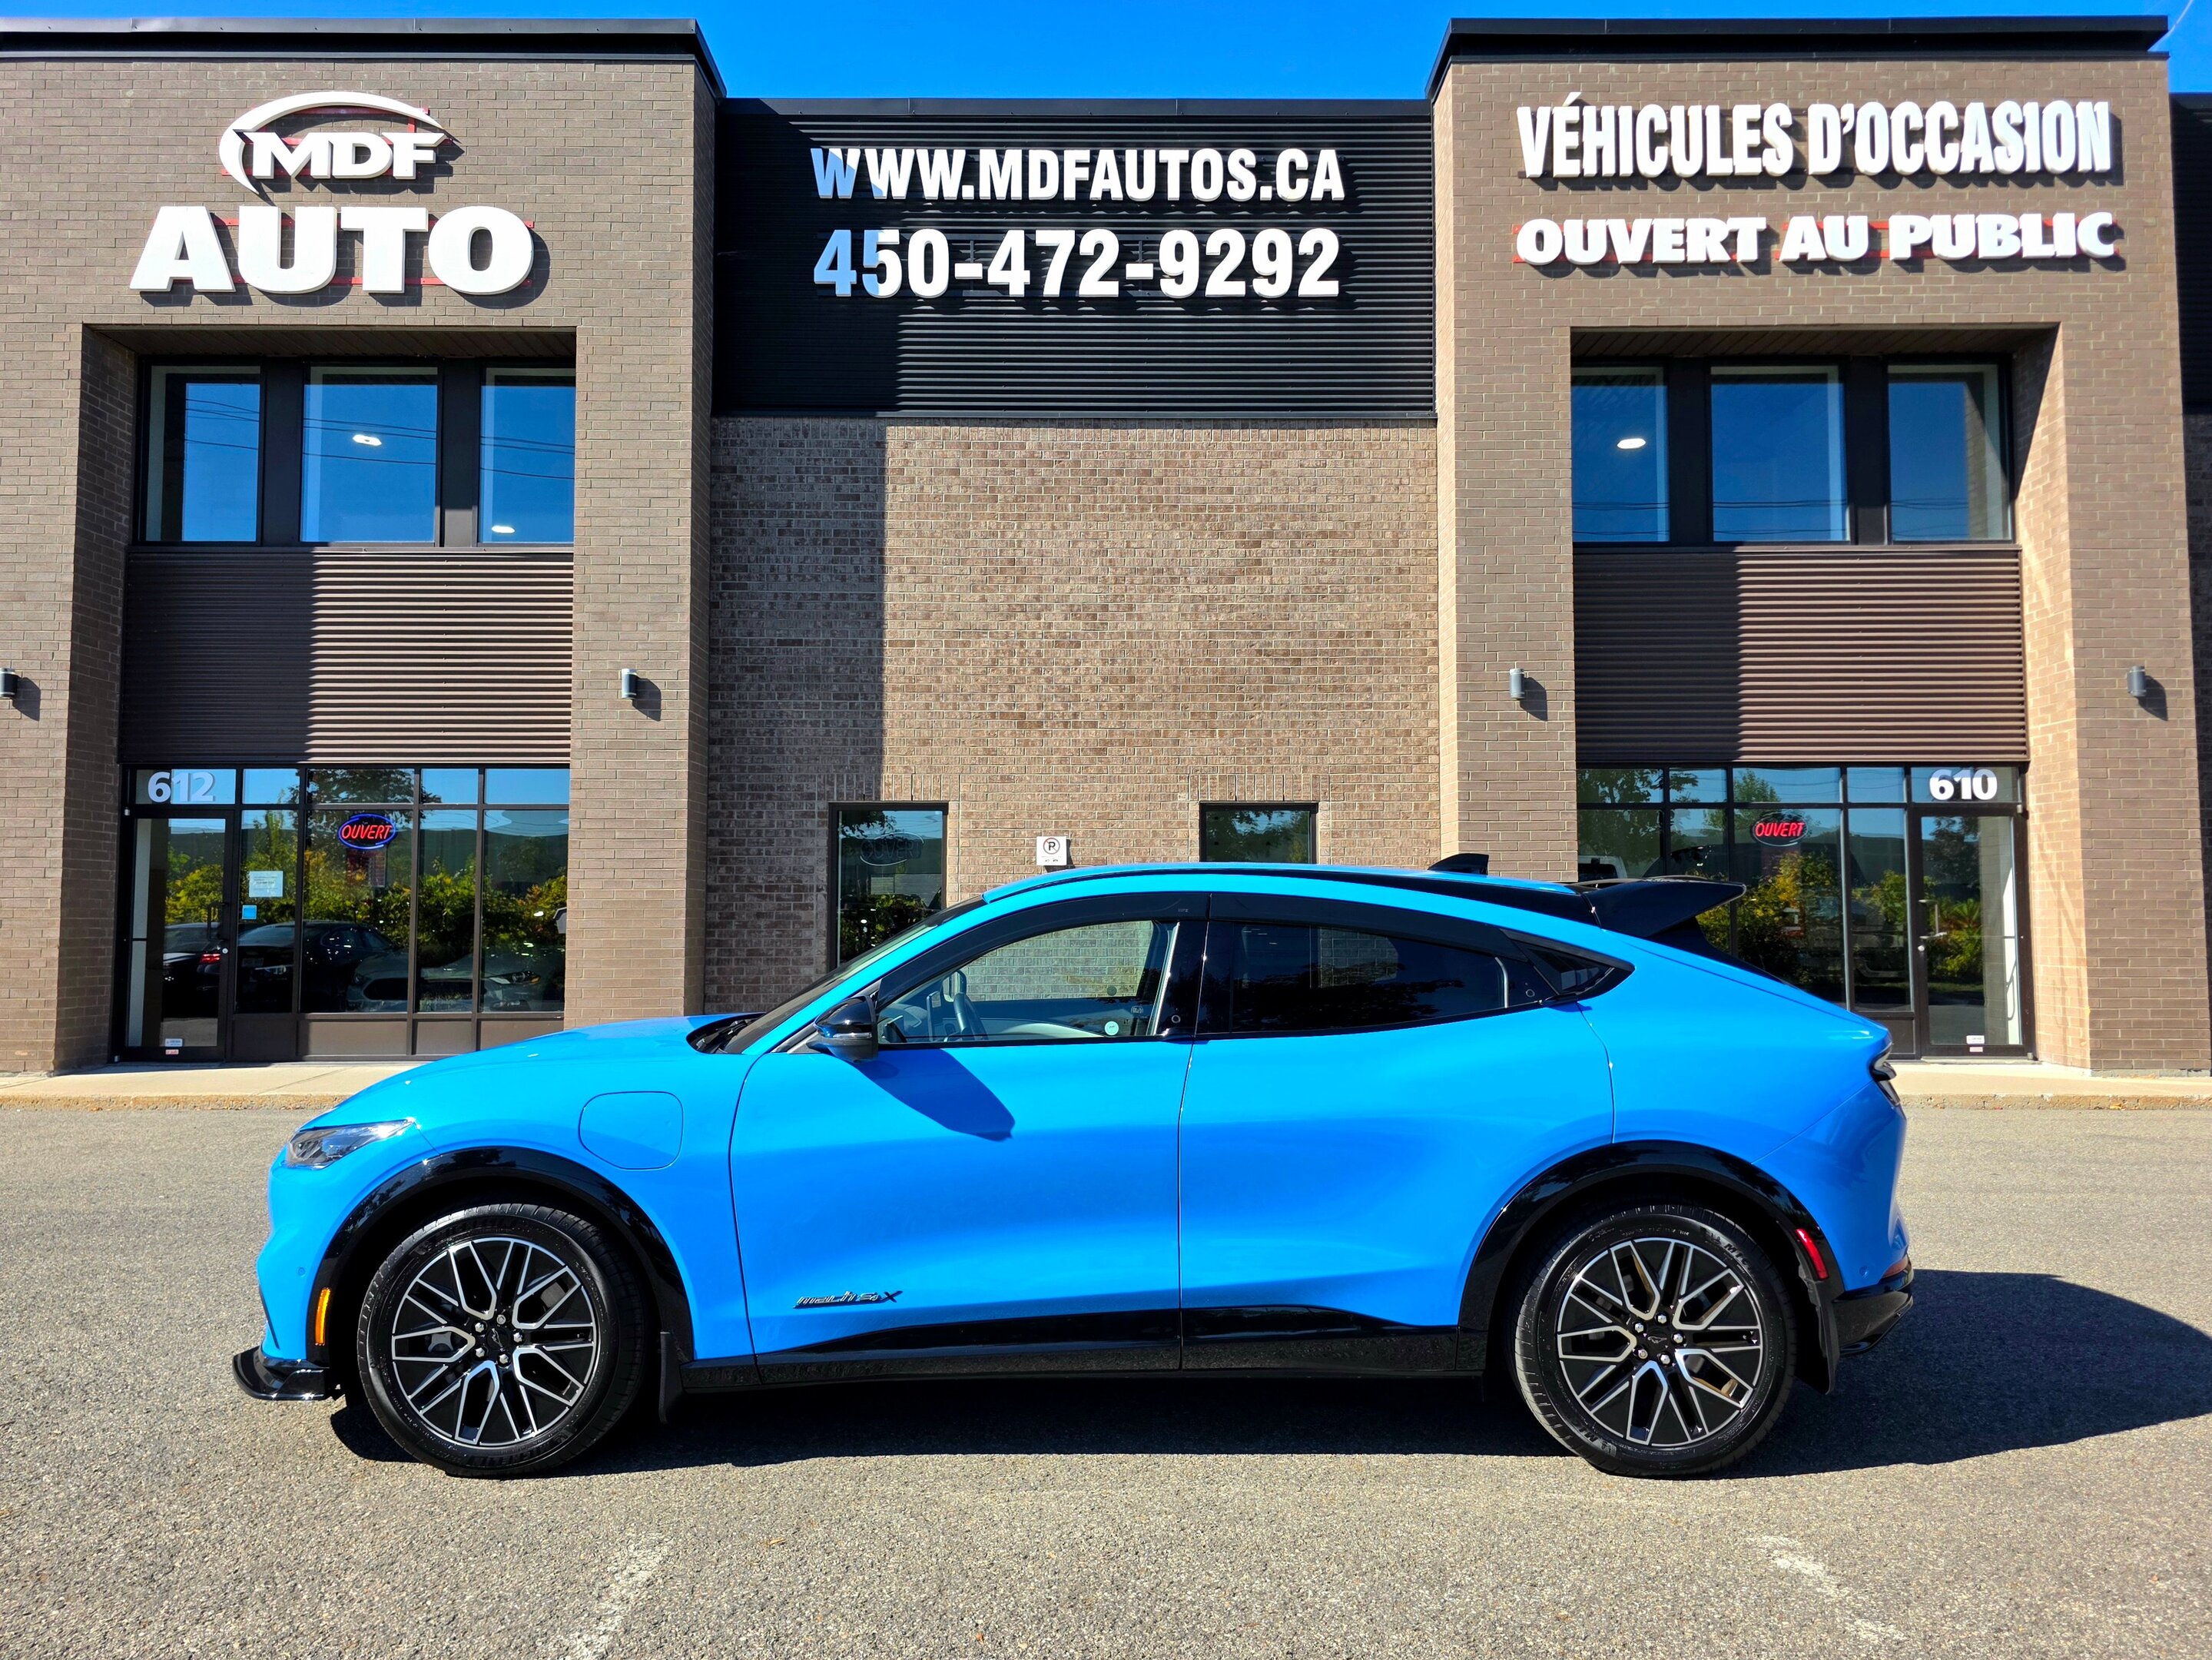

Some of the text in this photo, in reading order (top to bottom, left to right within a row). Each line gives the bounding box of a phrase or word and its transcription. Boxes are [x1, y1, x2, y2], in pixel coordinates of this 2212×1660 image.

[243, 131, 449, 180] MDF
[1516, 91, 1795, 179] VÉHICULES
[810, 148, 1345, 202] WWW.MDFAUTOS.CA
[129, 205, 535, 296] AUTO
[813, 227, 1341, 299] 450-472-9292
[1515, 211, 2117, 266] OUVERT AU PUBLIC
[148, 771, 215, 803] 612
[1929, 769, 1998, 801] 610
[341, 824, 393, 839] OUVERT
[1755, 822, 1806, 837] OUVERT
